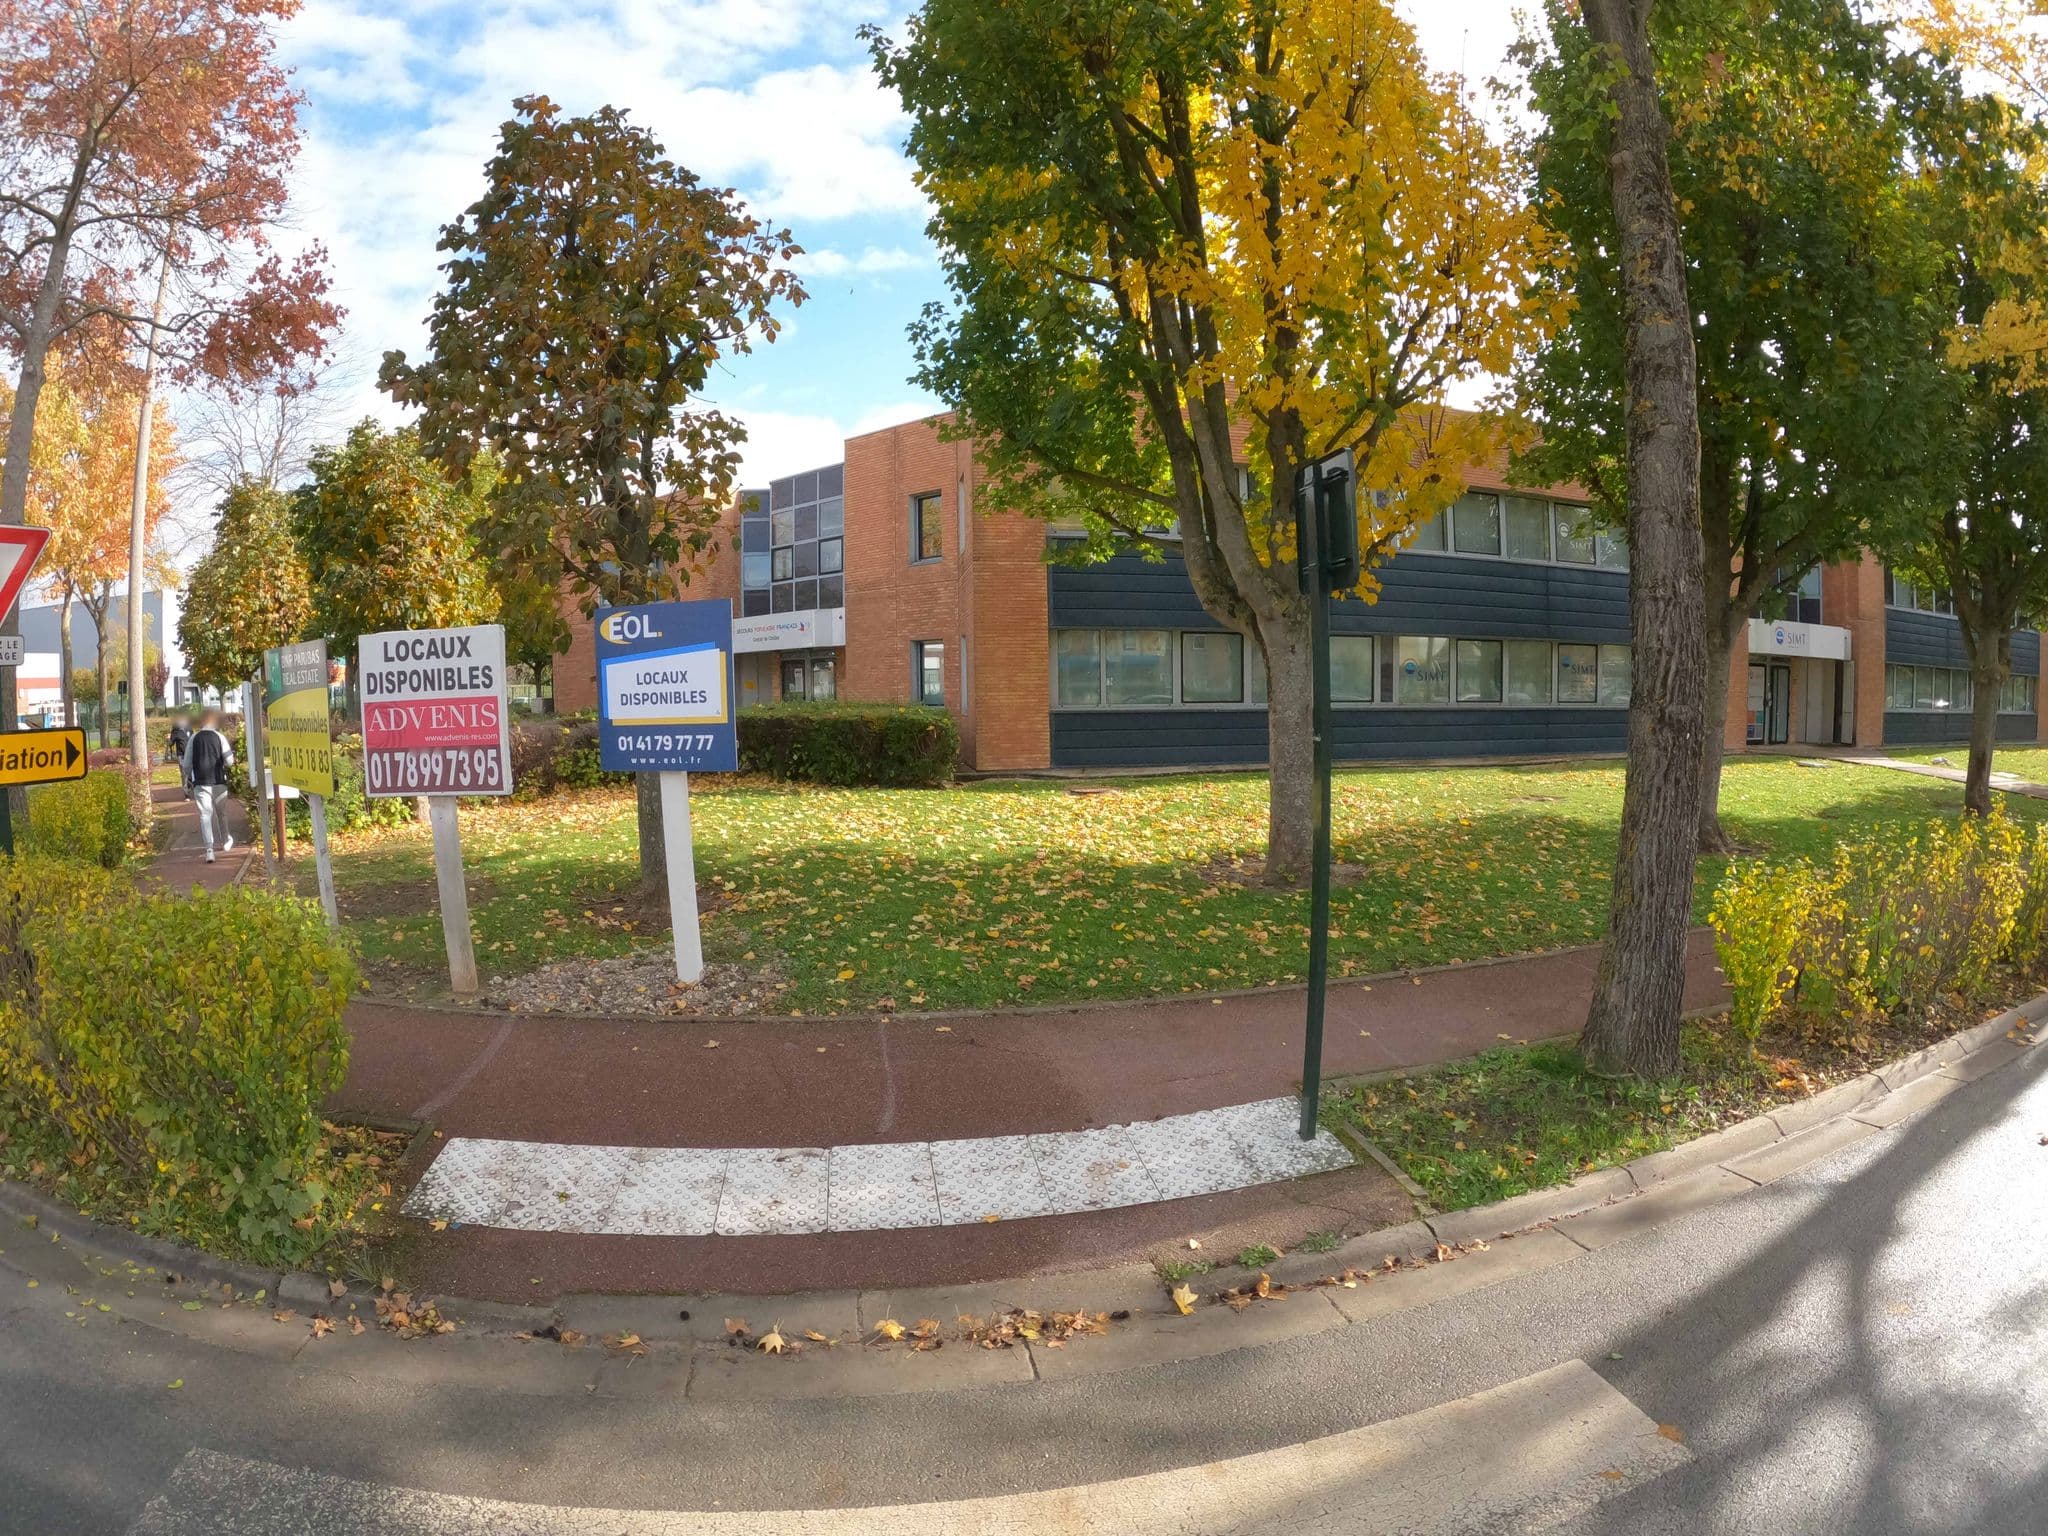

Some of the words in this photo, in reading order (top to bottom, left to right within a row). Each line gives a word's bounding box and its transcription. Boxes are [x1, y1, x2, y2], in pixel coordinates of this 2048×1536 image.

[1787, 632, 1807, 646] SIMT
[383, 635, 472, 663] LOCAUX
[1417, 670, 1444, 682] SIMT
[1571, 663, 1595, 675] SIMT
[366, 665, 494, 695] DISPONIBLES
[636, 670, 688, 686] LOCAUX
[620, 690, 707, 706] DISPONIBLES
[368, 702, 498, 732] ADVENIS
[424, 732, 498, 742] www.advenis-res.com
[272, 746, 281, 766] 01
[294, 748, 304, 770] 15
[306, 749, 316, 772] 18
[318, 749, 330, 774] 83
